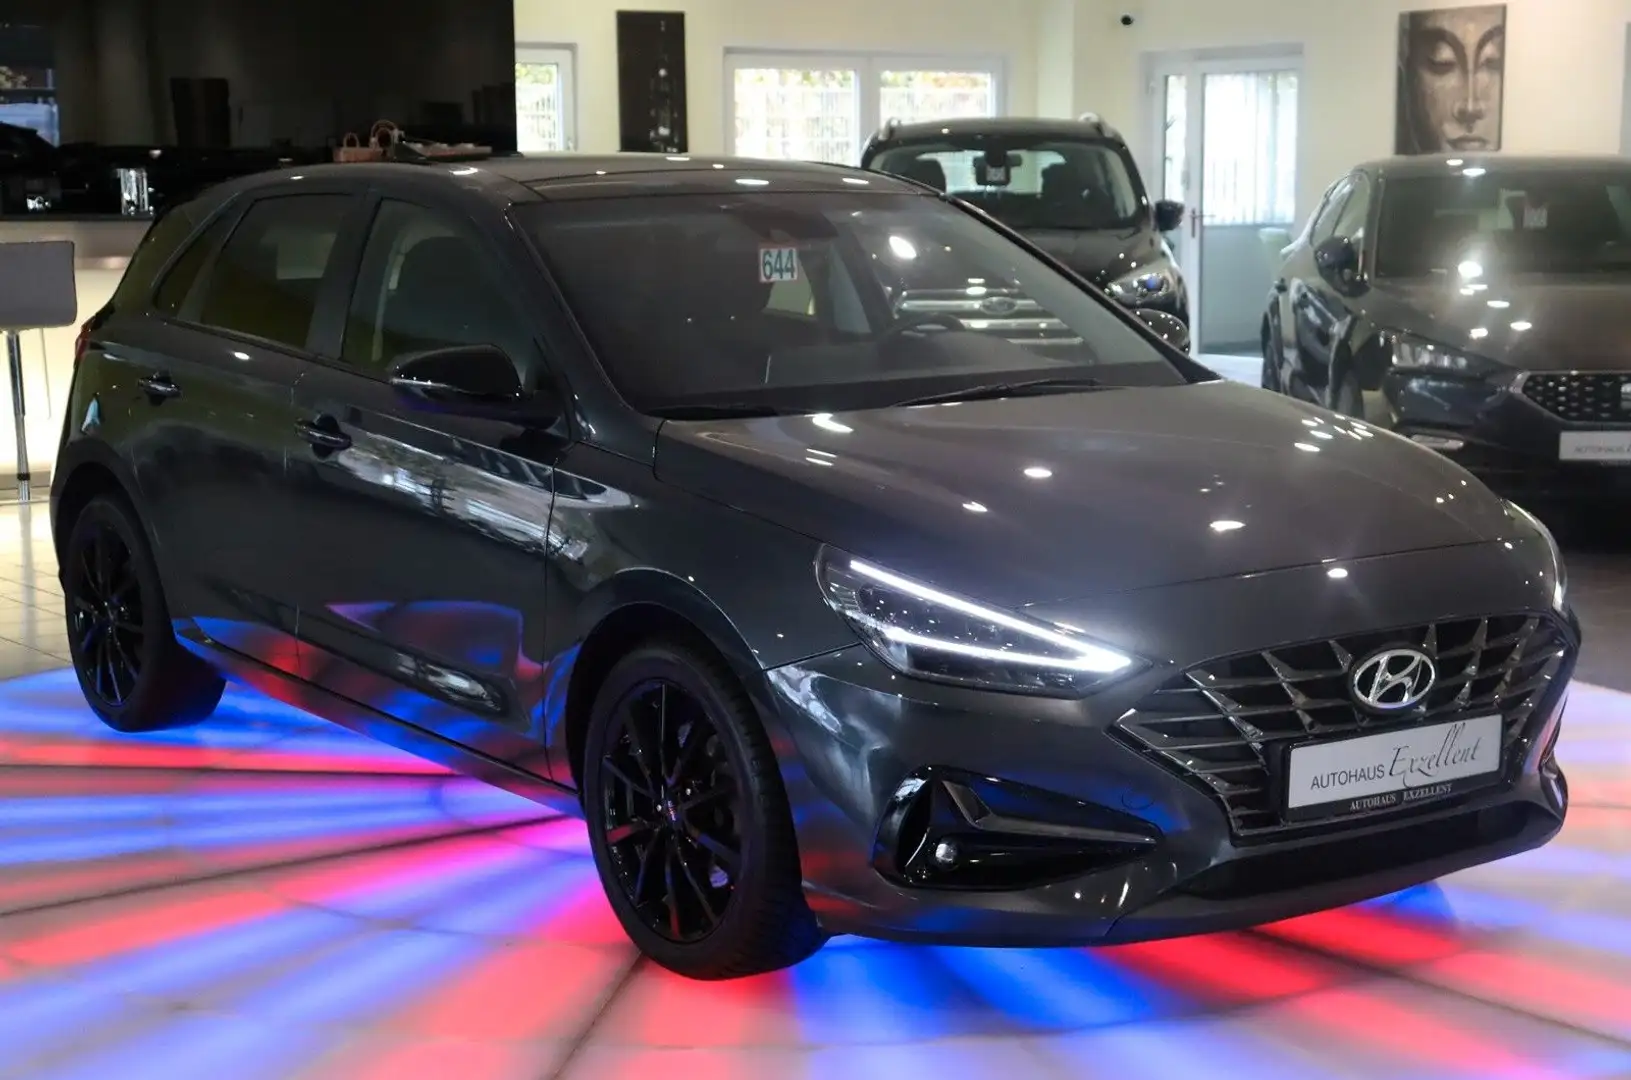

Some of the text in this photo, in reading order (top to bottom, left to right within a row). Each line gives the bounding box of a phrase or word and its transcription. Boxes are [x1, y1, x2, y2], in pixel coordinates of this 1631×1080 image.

[762, 249, 795, 281] 644
[1311, 722, 1482, 790] AUTOHAUS Exzellent
[1350, 784, 1452, 811] AUTOHAUS EXZELLENT
